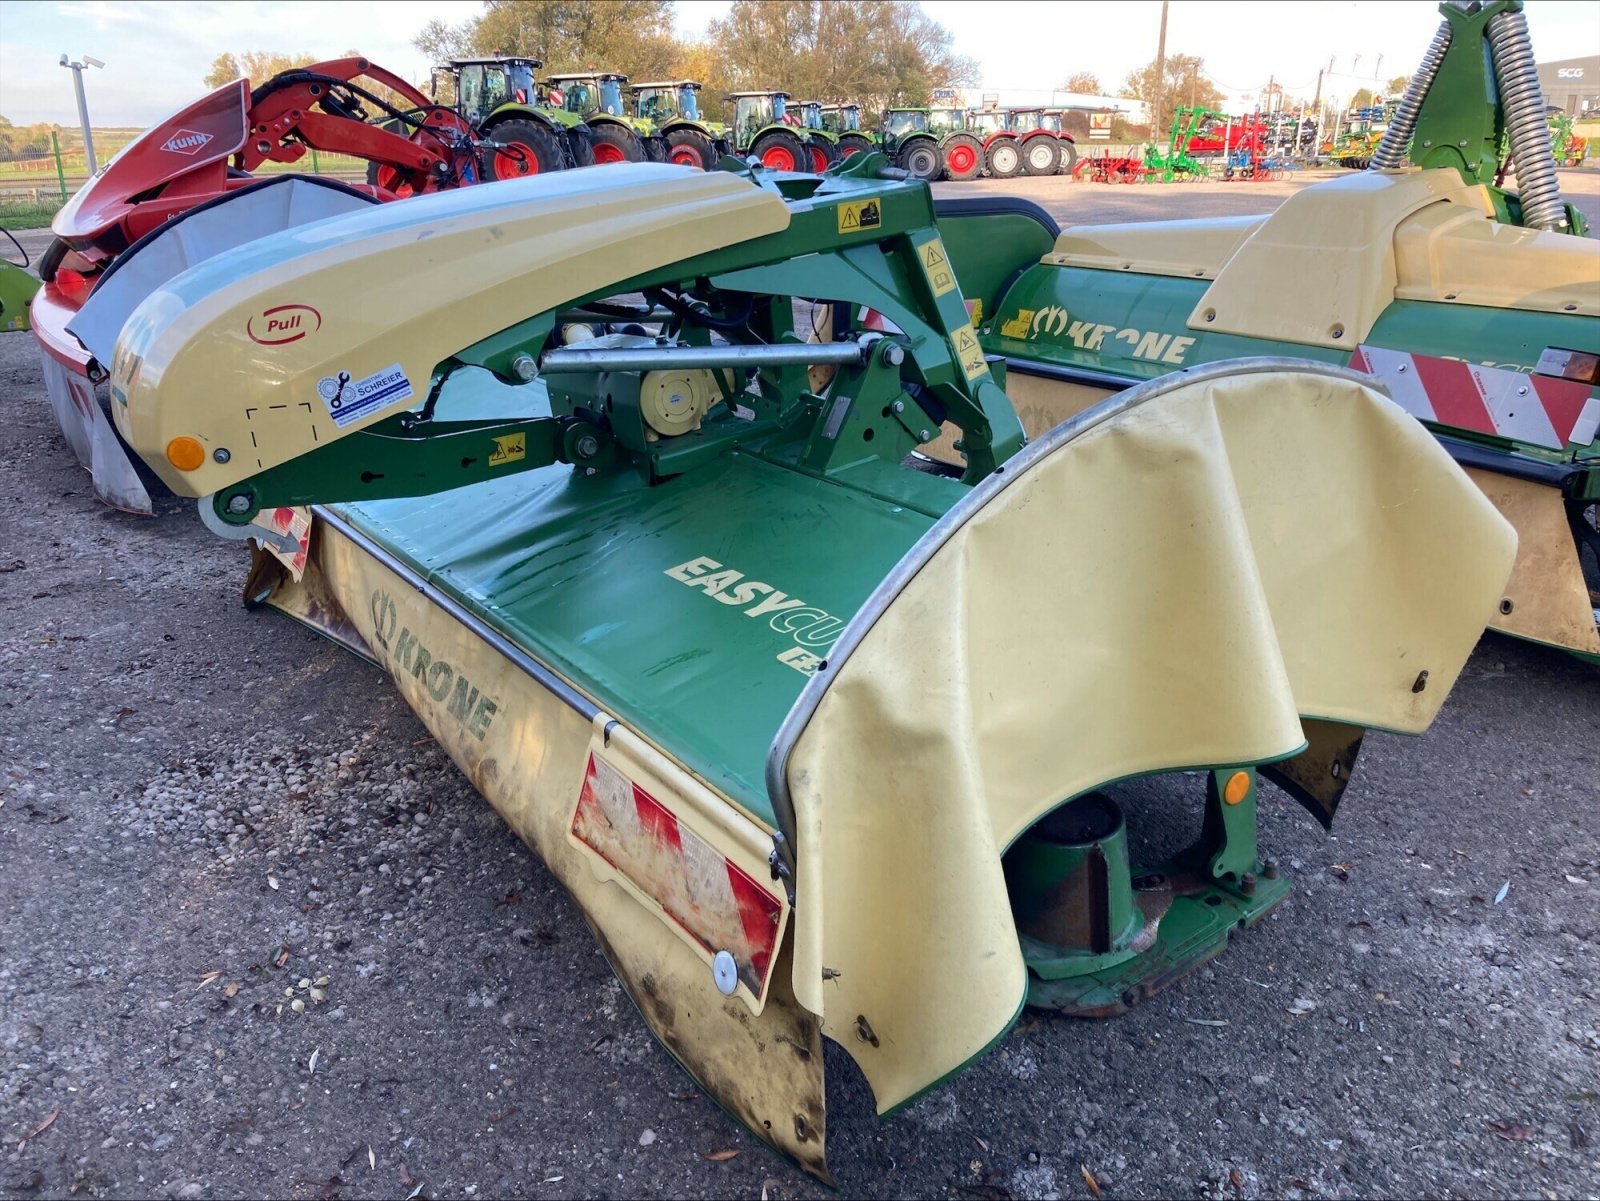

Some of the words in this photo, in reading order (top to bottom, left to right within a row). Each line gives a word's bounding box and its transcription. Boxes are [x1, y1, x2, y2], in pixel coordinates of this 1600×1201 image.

[1557, 67, 1584, 78] SCG
[167, 134, 207, 151] KUHN
[267, 315, 301, 332] Pull
[355, 373, 383, 389] CHRISTIAN
[357, 371, 403, 396] SCHREIER
[393, 626, 498, 742] KRONE
